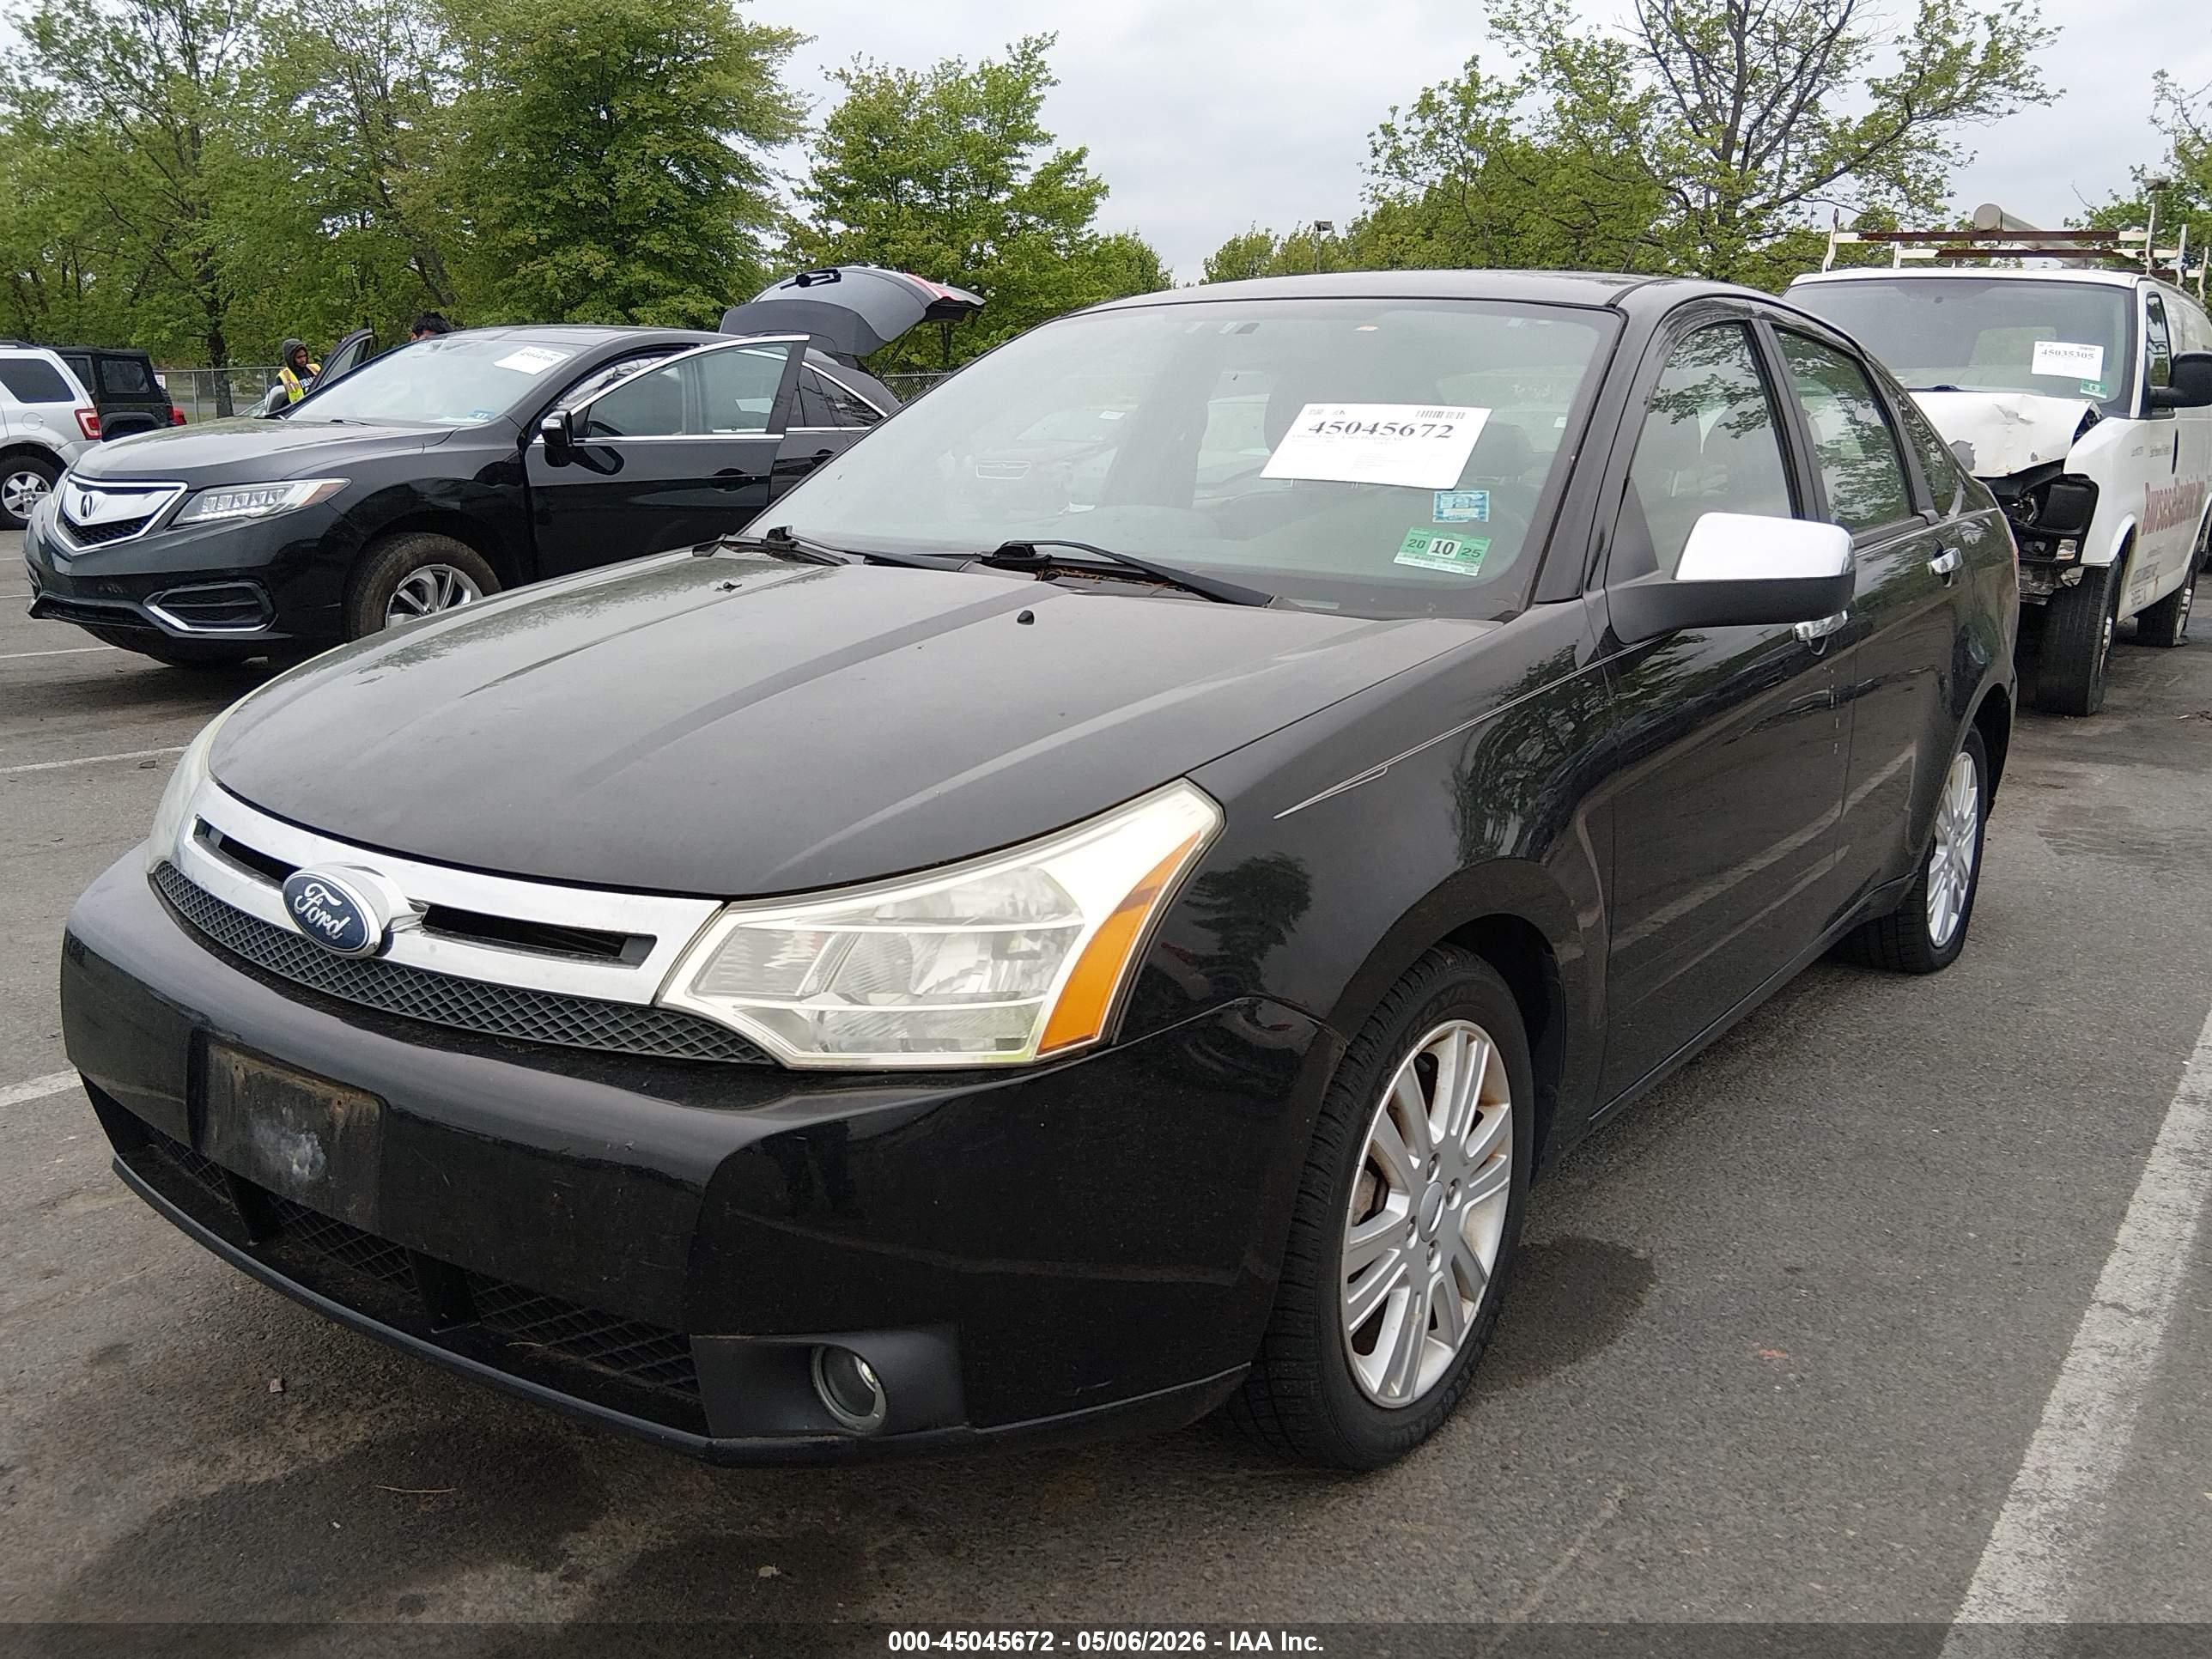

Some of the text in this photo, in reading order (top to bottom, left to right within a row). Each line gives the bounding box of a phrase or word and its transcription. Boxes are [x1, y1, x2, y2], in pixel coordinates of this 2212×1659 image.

[1308, 421, 1454, 439] 45045672
[1407, 538, 1482, 557] 20 10 25
[294, 883, 351, 939] Ford
